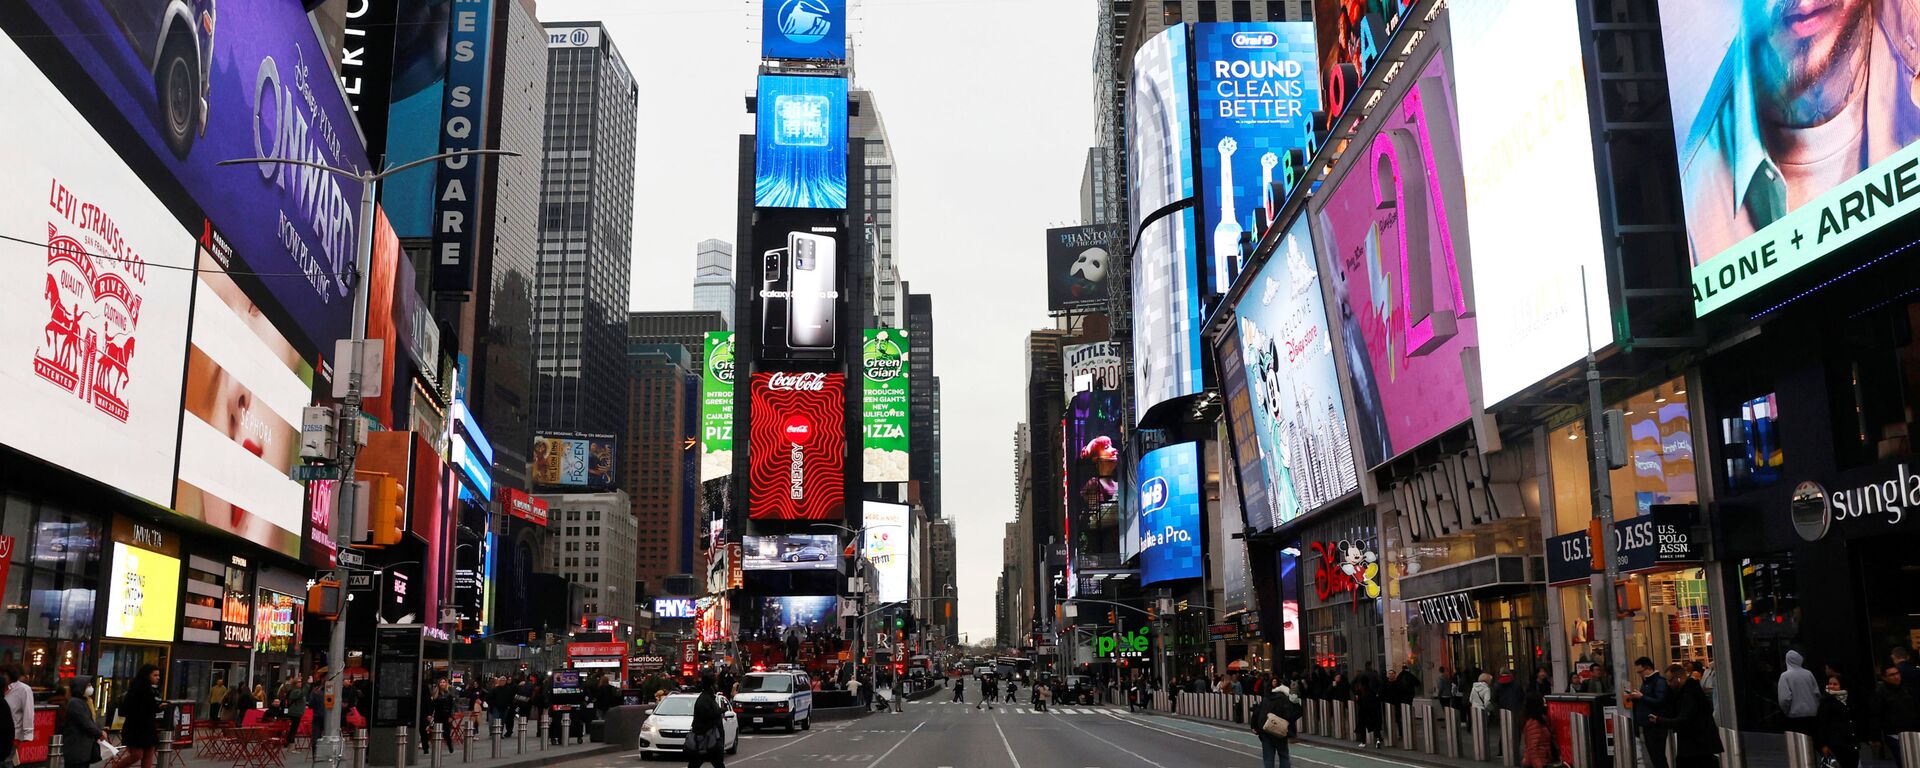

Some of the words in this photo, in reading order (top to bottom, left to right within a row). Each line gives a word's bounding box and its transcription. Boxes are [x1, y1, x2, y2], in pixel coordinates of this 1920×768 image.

[1235, 35, 1273, 46] Oral-B
[1215, 60, 1302, 79] ROUND
[1216, 80, 1303, 97] CLEANS
[1219, 99, 1303, 117] BETTER
[320, 106, 341, 166] PIXAR
[253, 55, 357, 297] ONWARD
[441, 86, 472, 265] SQUARE
[50, 177, 77, 224] LEVI
[79, 202, 124, 262] STRAUSS
[124, 247, 131, 272] &
[133, 254, 146, 286] CO.
[49, 240, 97, 290] ORIGINAL
[277, 209, 300, 262] NOW
[300, 240, 331, 305] PLAYING
[61, 269, 85, 299] QUALITY
[103, 302, 127, 330] CLOTHING
[864, 357, 900, 368] Green
[1071, 344, 1106, 367] LITTLE
[37, 362, 73, 389] PATENTED
[868, 368, 901, 378] Giant
[240, 408, 273, 444] SEPHORA
[302, 468, 311, 478] W
[316, 468, 327, 478] 45
[571, 442, 586, 482] FROZEN
[791, 442, 804, 499] ENERGY
[1391, 446, 1501, 546] FOREVER
[1158, 534, 1163, 544] a
[1166, 526, 1191, 543] Pro.
[1657, 525, 1677, 534] U.S.
[1659, 534, 1687, 543] POLO
[1562, 538, 1583, 562] U.S.
[1660, 544, 1690, 553] ASSN.
[1417, 594, 1464, 625] FOREVER
[1464, 593, 1479, 620] 21
[224, 625, 252, 642] SEPHORA
[877, 632, 890, 649] R
